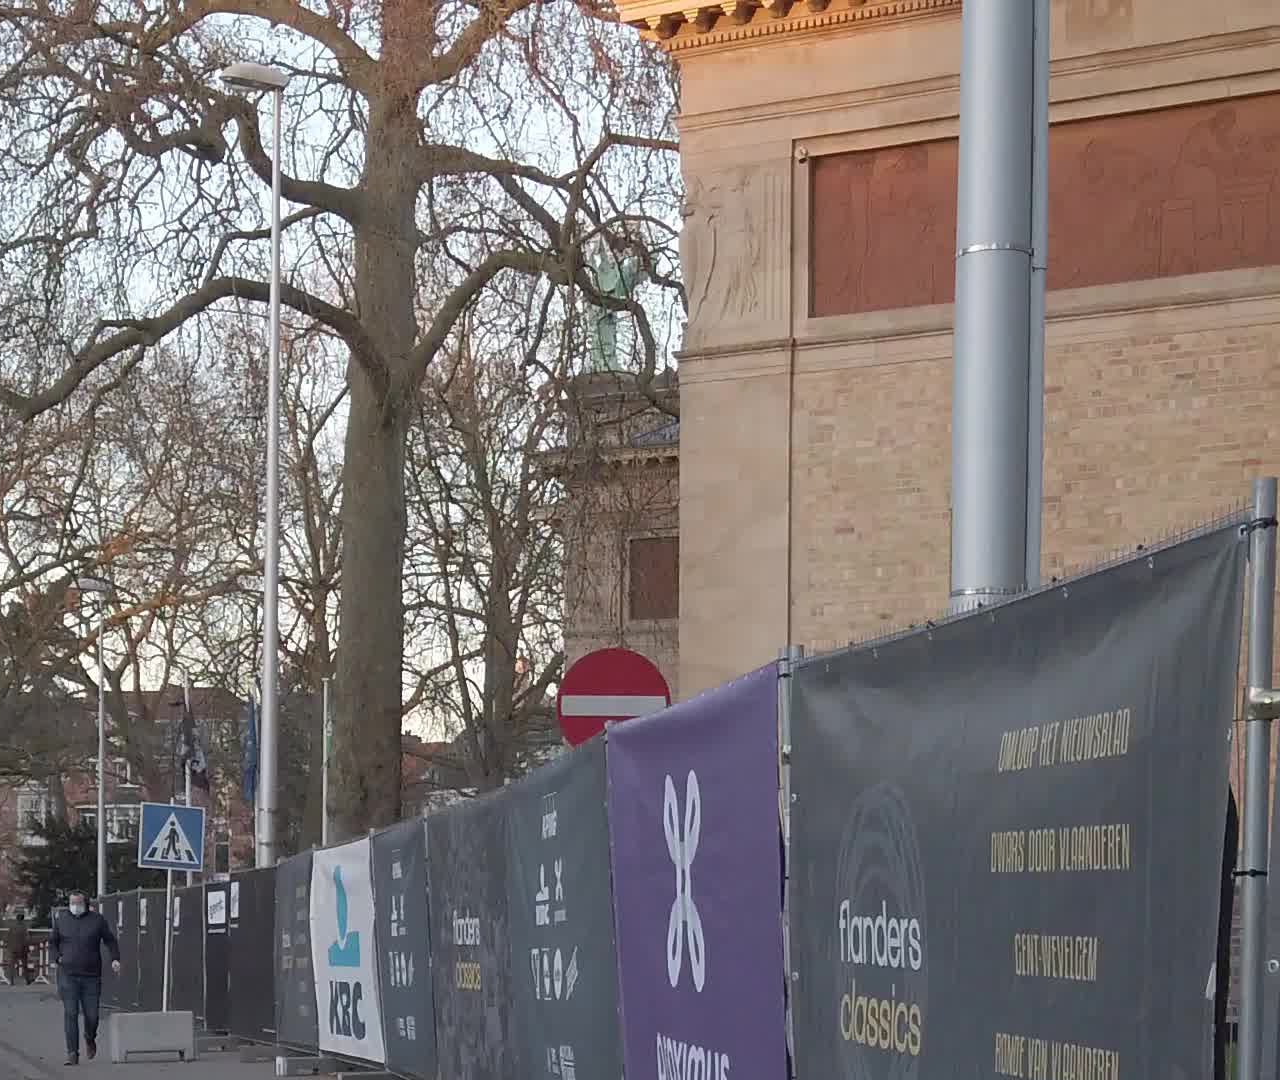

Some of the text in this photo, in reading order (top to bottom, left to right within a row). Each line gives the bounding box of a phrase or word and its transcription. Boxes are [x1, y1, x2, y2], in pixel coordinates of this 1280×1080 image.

[998, 708, 1131, 773] OMLOOP HET NIEUWSBLAD
[990, 823, 1130, 873] DWARS DOOR VLAANDEREN
[839, 899, 922, 971] flanders
[1014, 932, 1098, 982] GENT-WEVELGEM
[329, 980, 366, 1041] KBC
[840, 978, 922, 1056] classics
[994, 1032, 1025, 1079] RONDE
